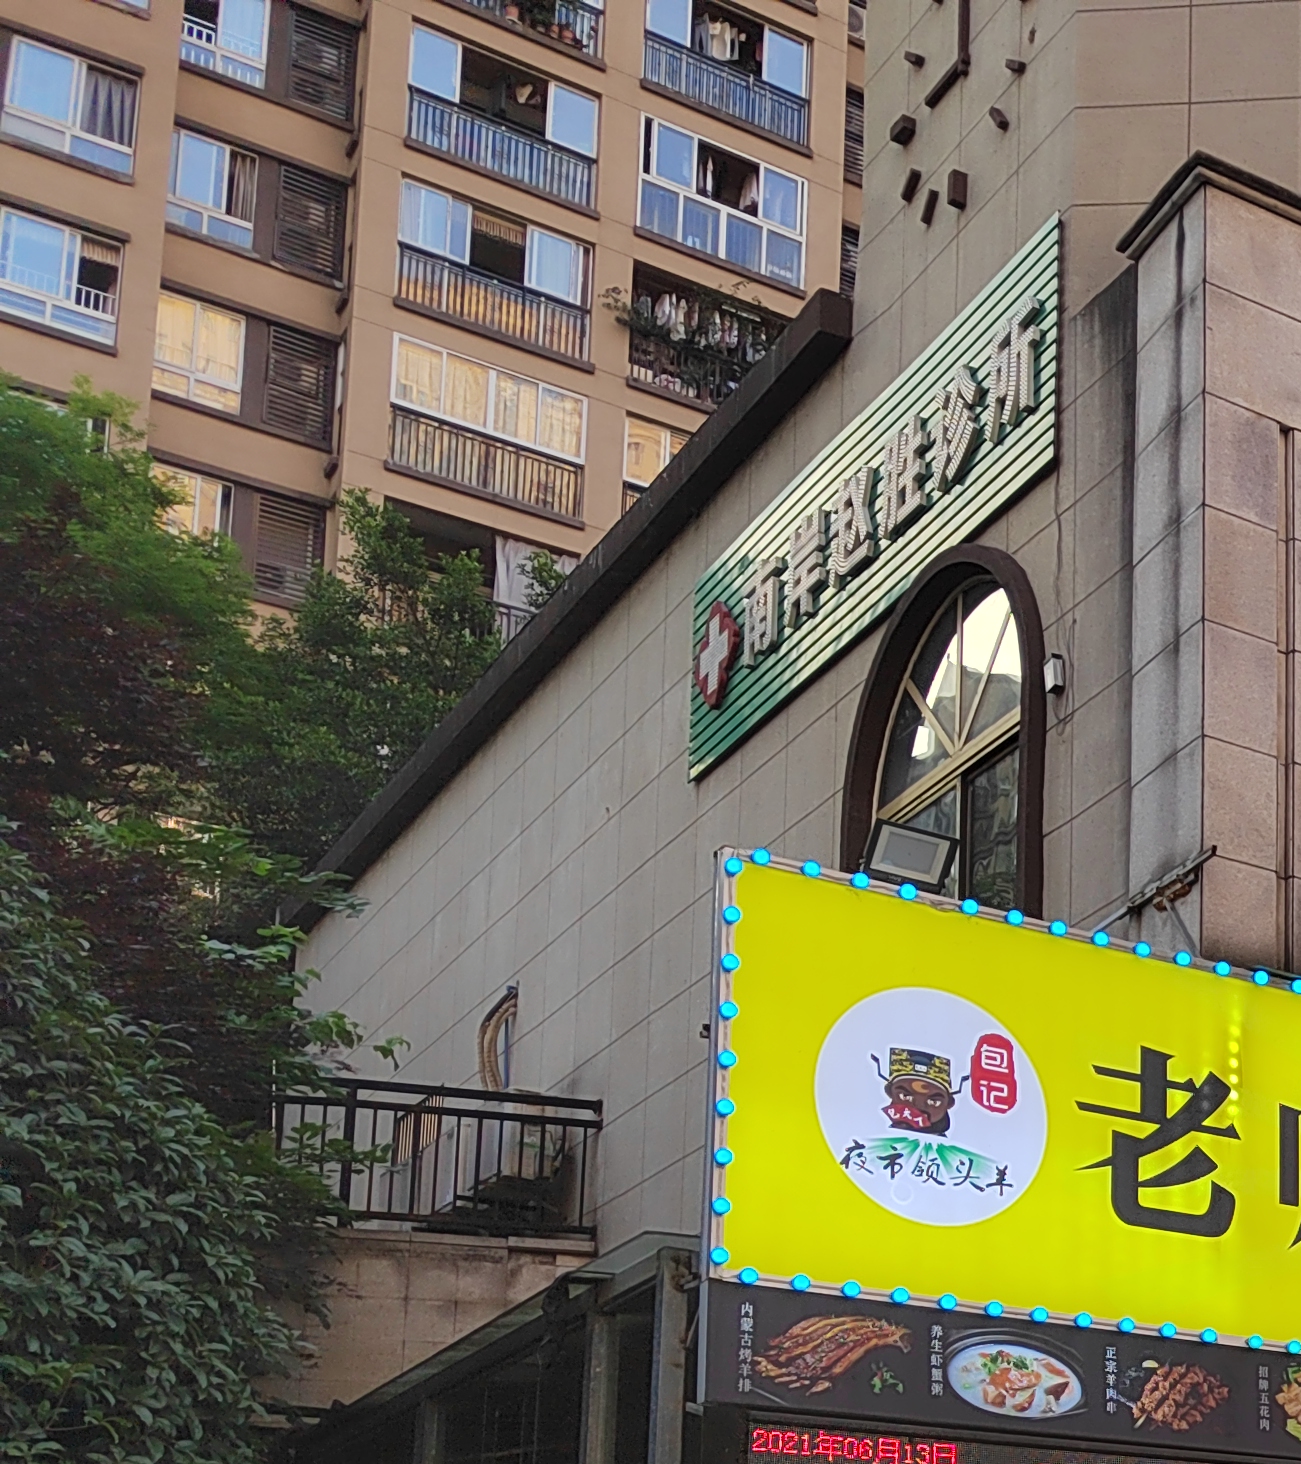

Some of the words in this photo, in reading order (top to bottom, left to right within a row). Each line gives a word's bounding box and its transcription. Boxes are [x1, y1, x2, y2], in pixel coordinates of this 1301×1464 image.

[740, 296, 1042, 668] 南岸赵胜诊所
[979, 1043, 1010, 1110] 包记
[840, 1139, 1015, 1197] 夜市领头羊
[738, 1301, 754, 1393] 内蒙古烤羊排
[930, 1324, 944, 1397] 养生虾蟹粥
[1104, 1346, 1118, 1414] 正宗羊肉串
[1258, 1365, 1271, 1432] 招牌五花肉
